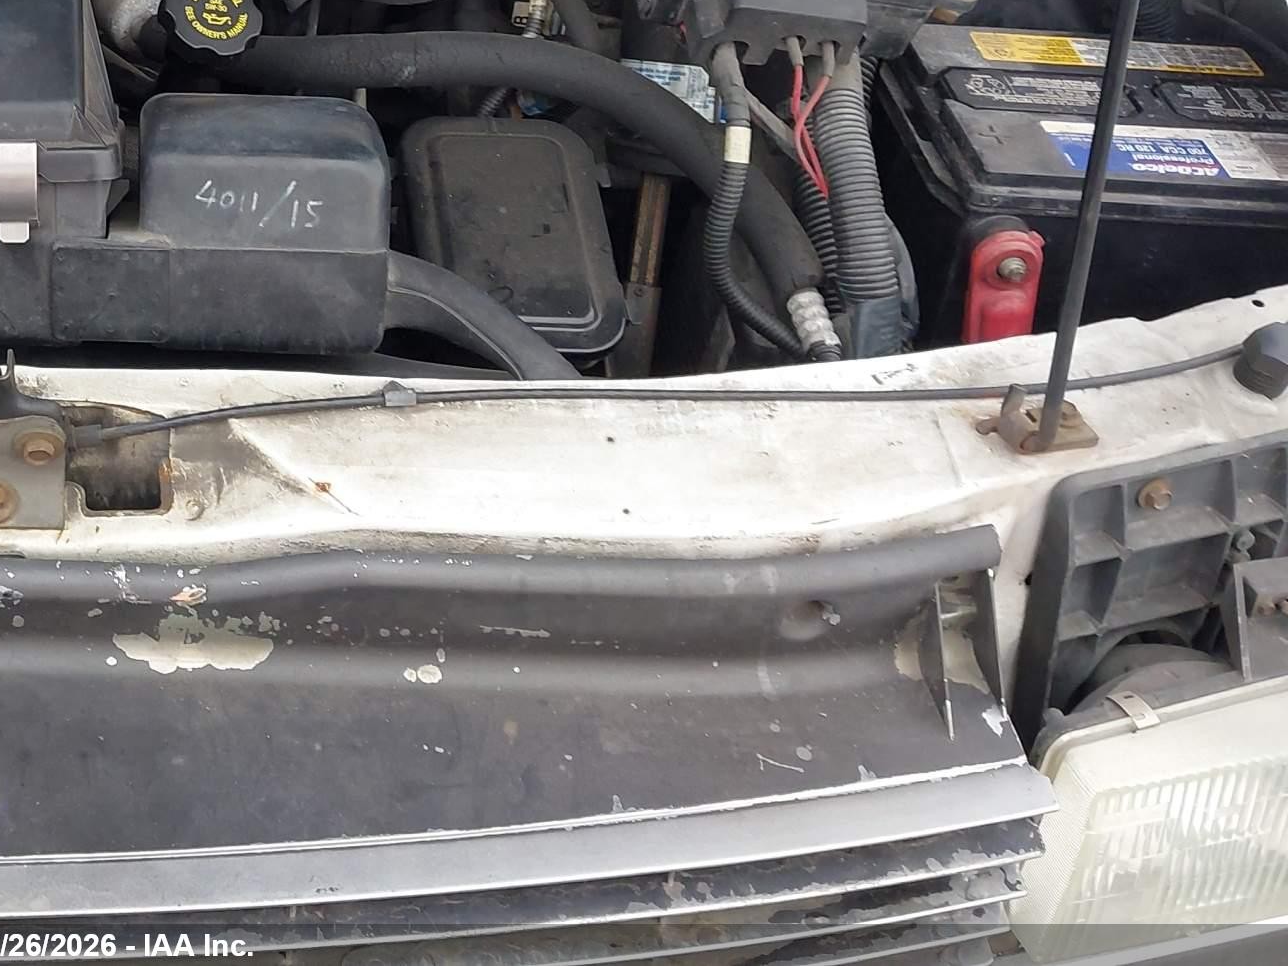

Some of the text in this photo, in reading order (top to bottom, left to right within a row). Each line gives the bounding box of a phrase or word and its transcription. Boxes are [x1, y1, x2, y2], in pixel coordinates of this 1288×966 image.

[184, 5, 248, 40] SEE OWNER'S MANUAL
[1116, 143, 1135, 152] RC
[1159, 145, 1187, 154] CCA
[1132, 153, 1215, 165] Professional
[1131, 163, 1220, 176] ACDelco
